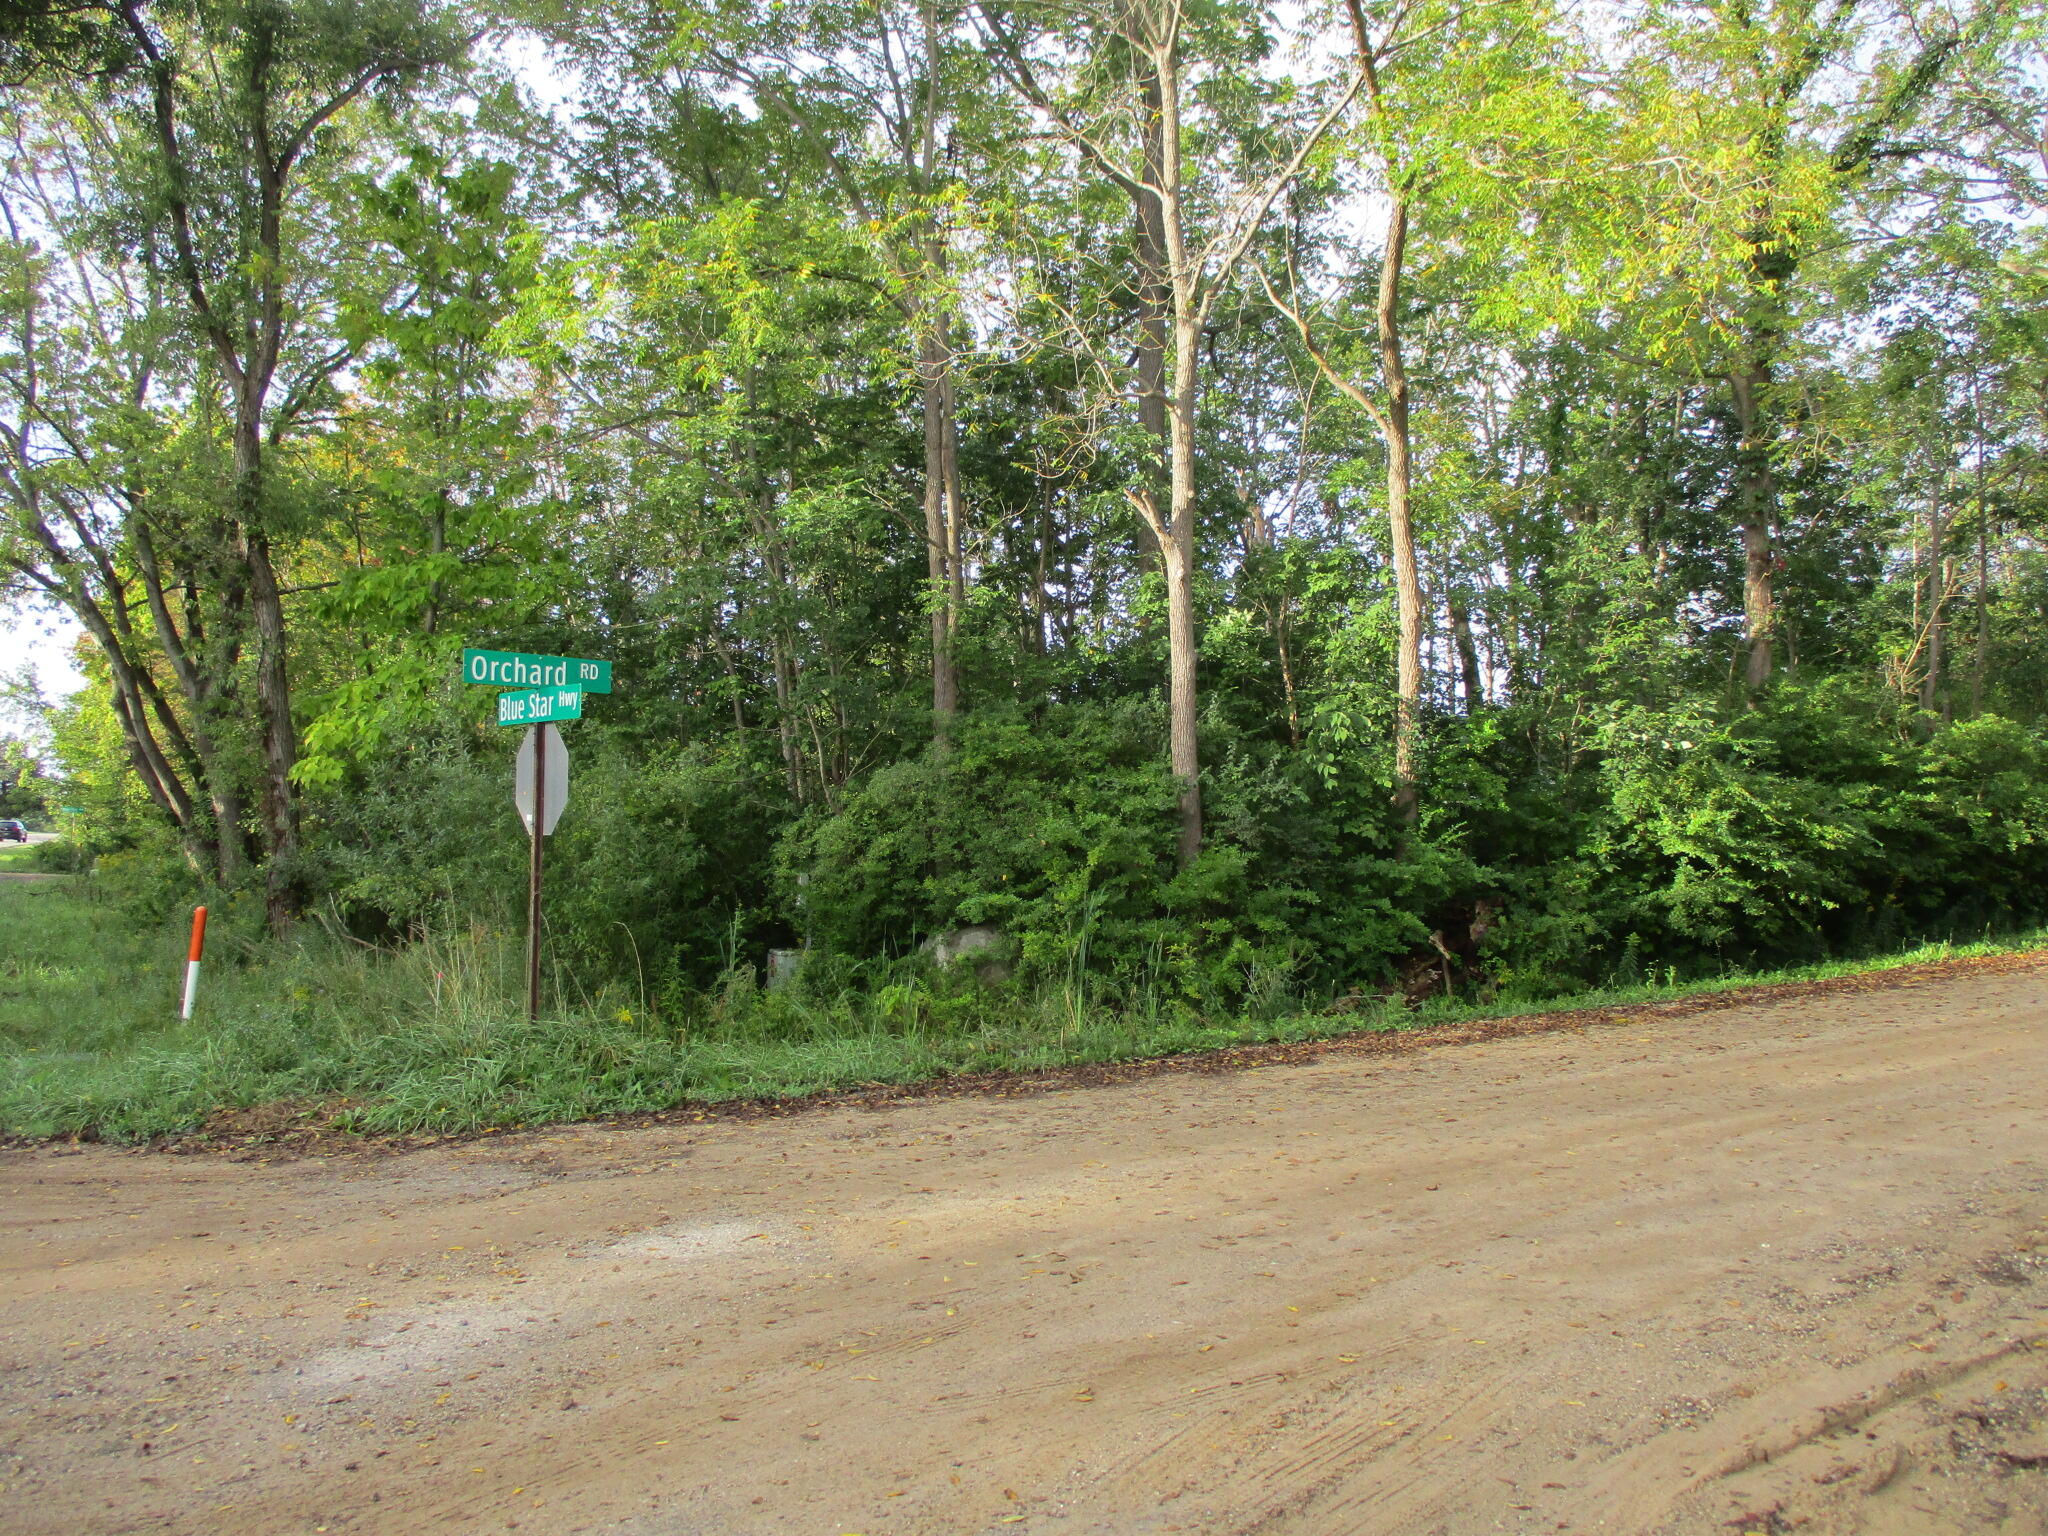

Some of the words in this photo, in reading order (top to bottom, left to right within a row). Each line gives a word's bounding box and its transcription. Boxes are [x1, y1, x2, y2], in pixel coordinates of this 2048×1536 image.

[472, 656, 566, 686] Orchard
[580, 663, 599, 680] RD
[500, 696, 525, 721] Blue
[529, 693, 554, 718] Star
[558, 691, 578, 710] Hwy
